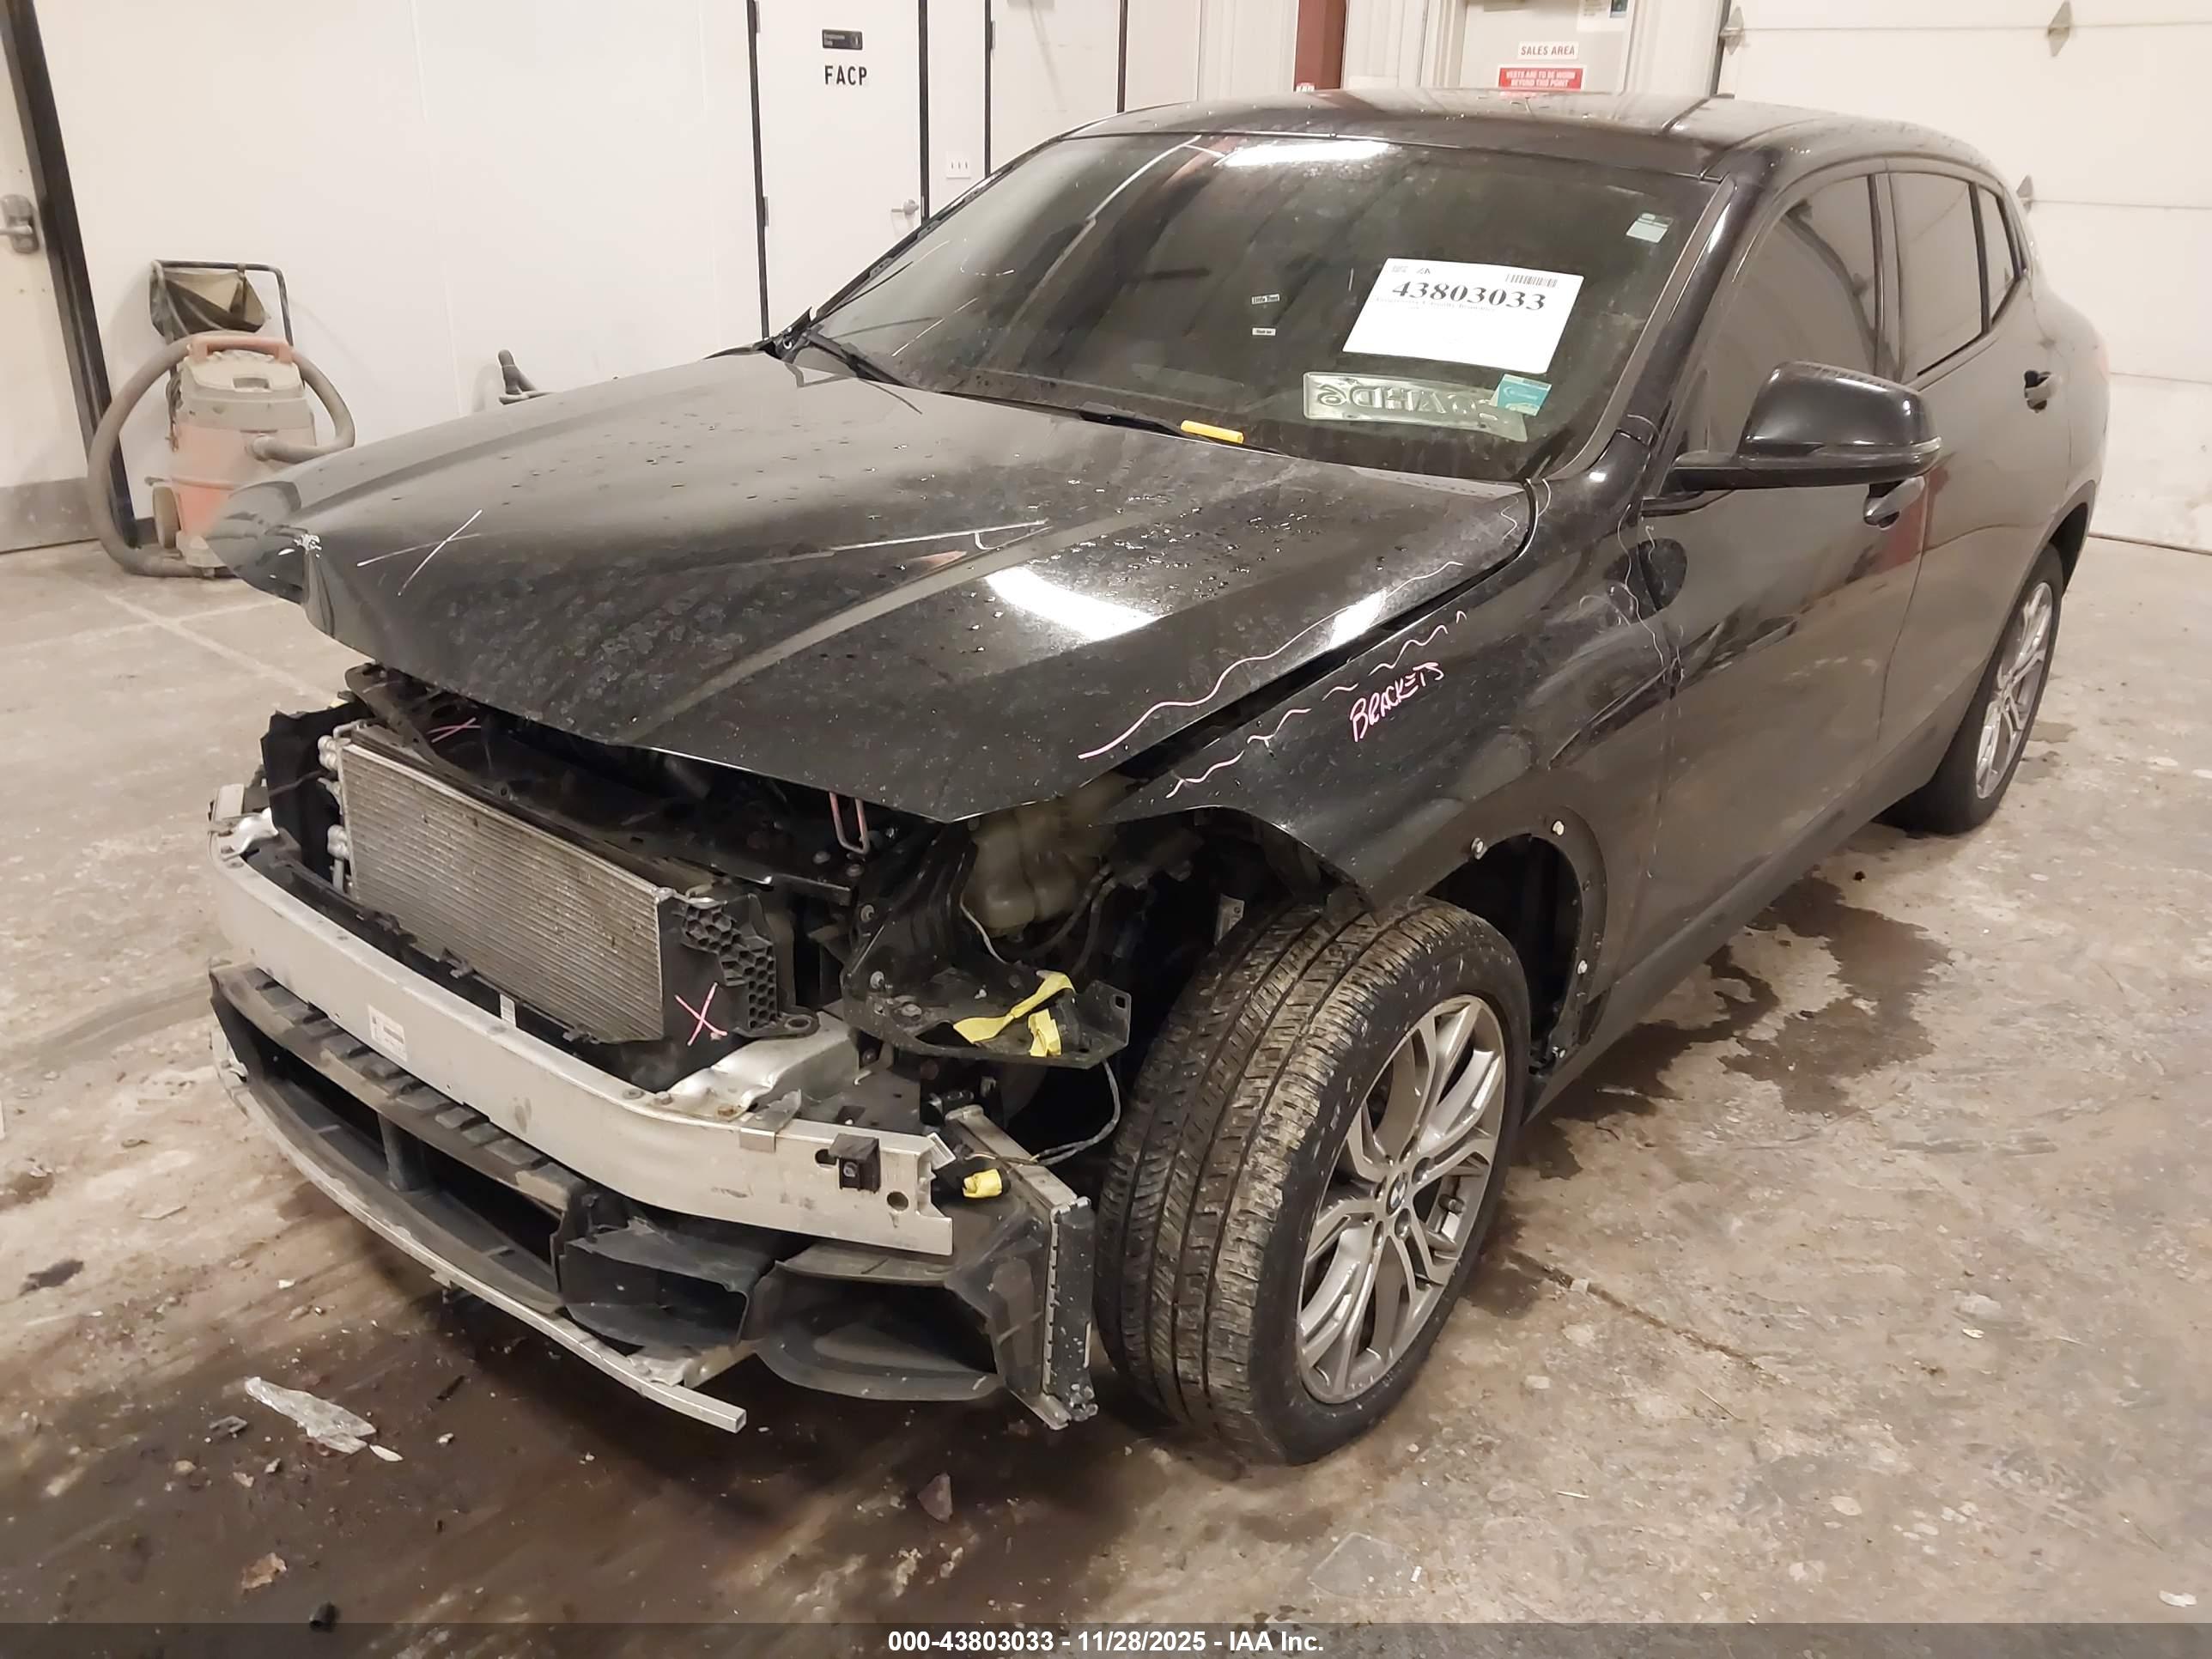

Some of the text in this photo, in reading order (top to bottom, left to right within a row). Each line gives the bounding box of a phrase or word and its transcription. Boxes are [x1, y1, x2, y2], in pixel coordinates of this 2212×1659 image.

[1521, 45, 1575, 56] SALES AREA
[824, 64, 867, 86] FACP
[1392, 281, 1546, 311] 43803033
[1349, 661, 1444, 743] BRACKETS
